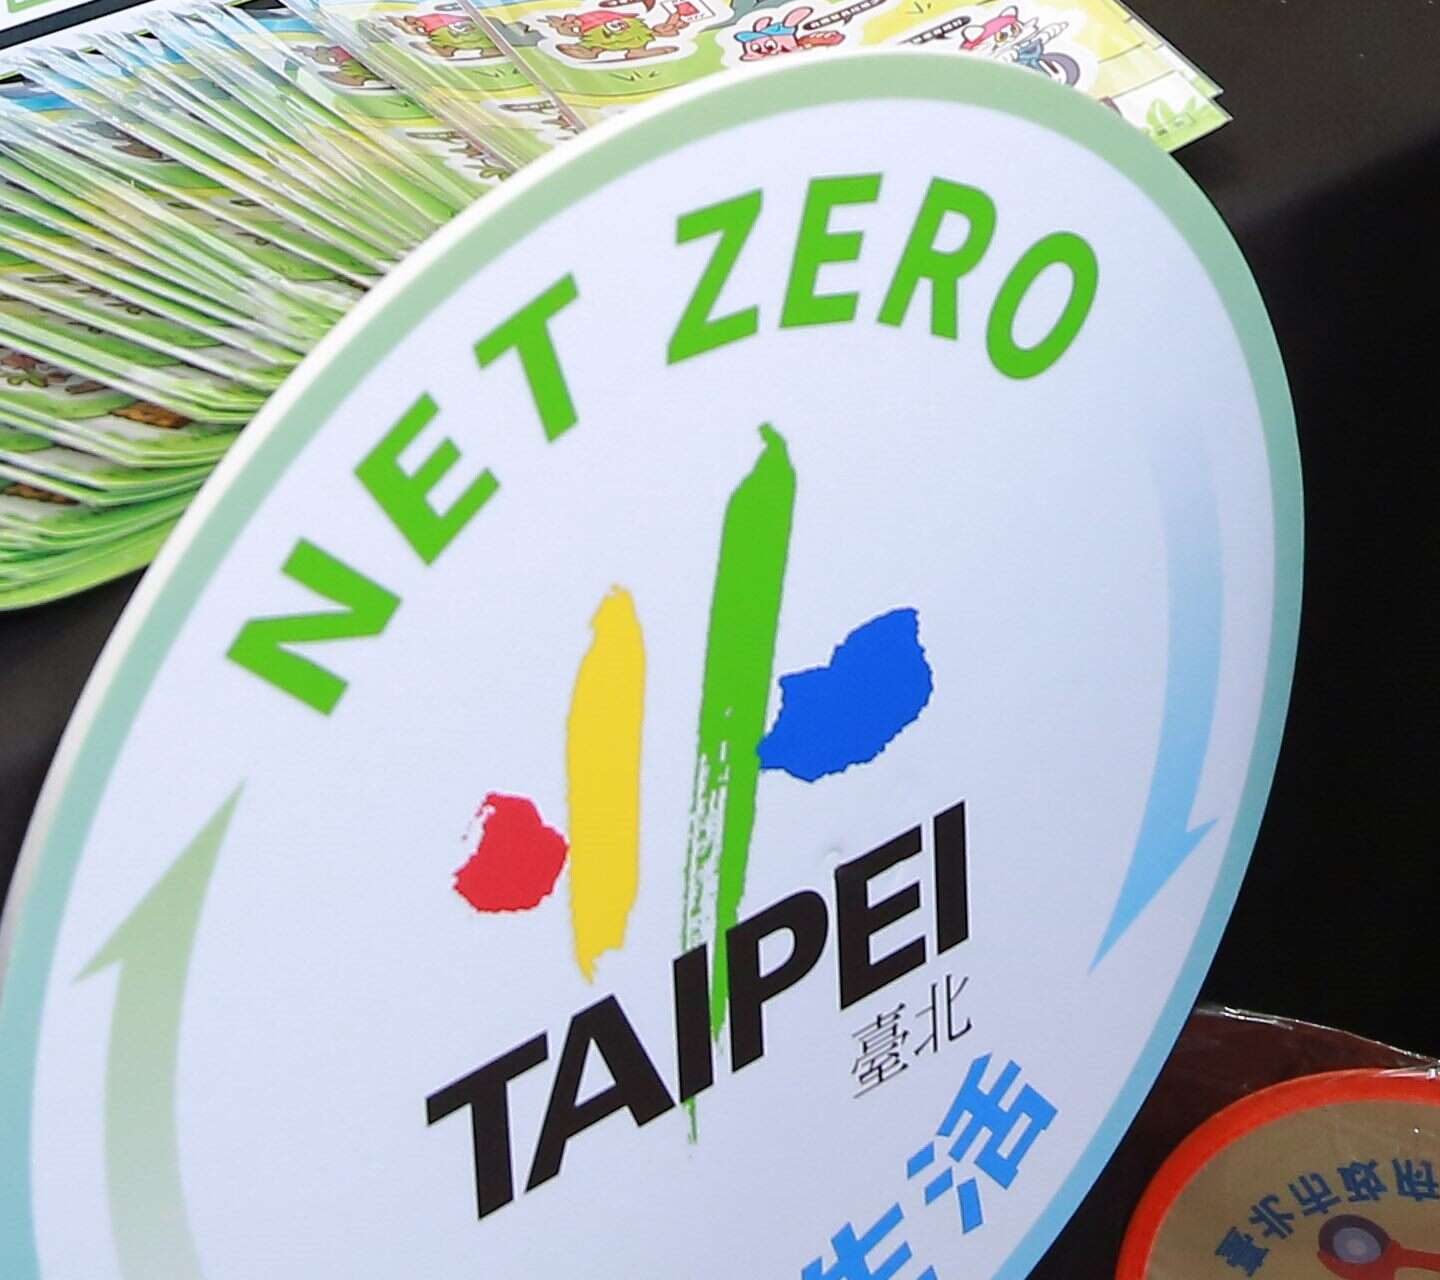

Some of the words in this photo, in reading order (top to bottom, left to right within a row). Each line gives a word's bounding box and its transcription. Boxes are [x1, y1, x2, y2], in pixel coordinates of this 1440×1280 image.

[226, 273, 581, 716] NET
[665, 171, 1100, 381] ZERO
[426, 802, 968, 1221] TAIPEI
[851, 974, 972, 1099] 臺北
